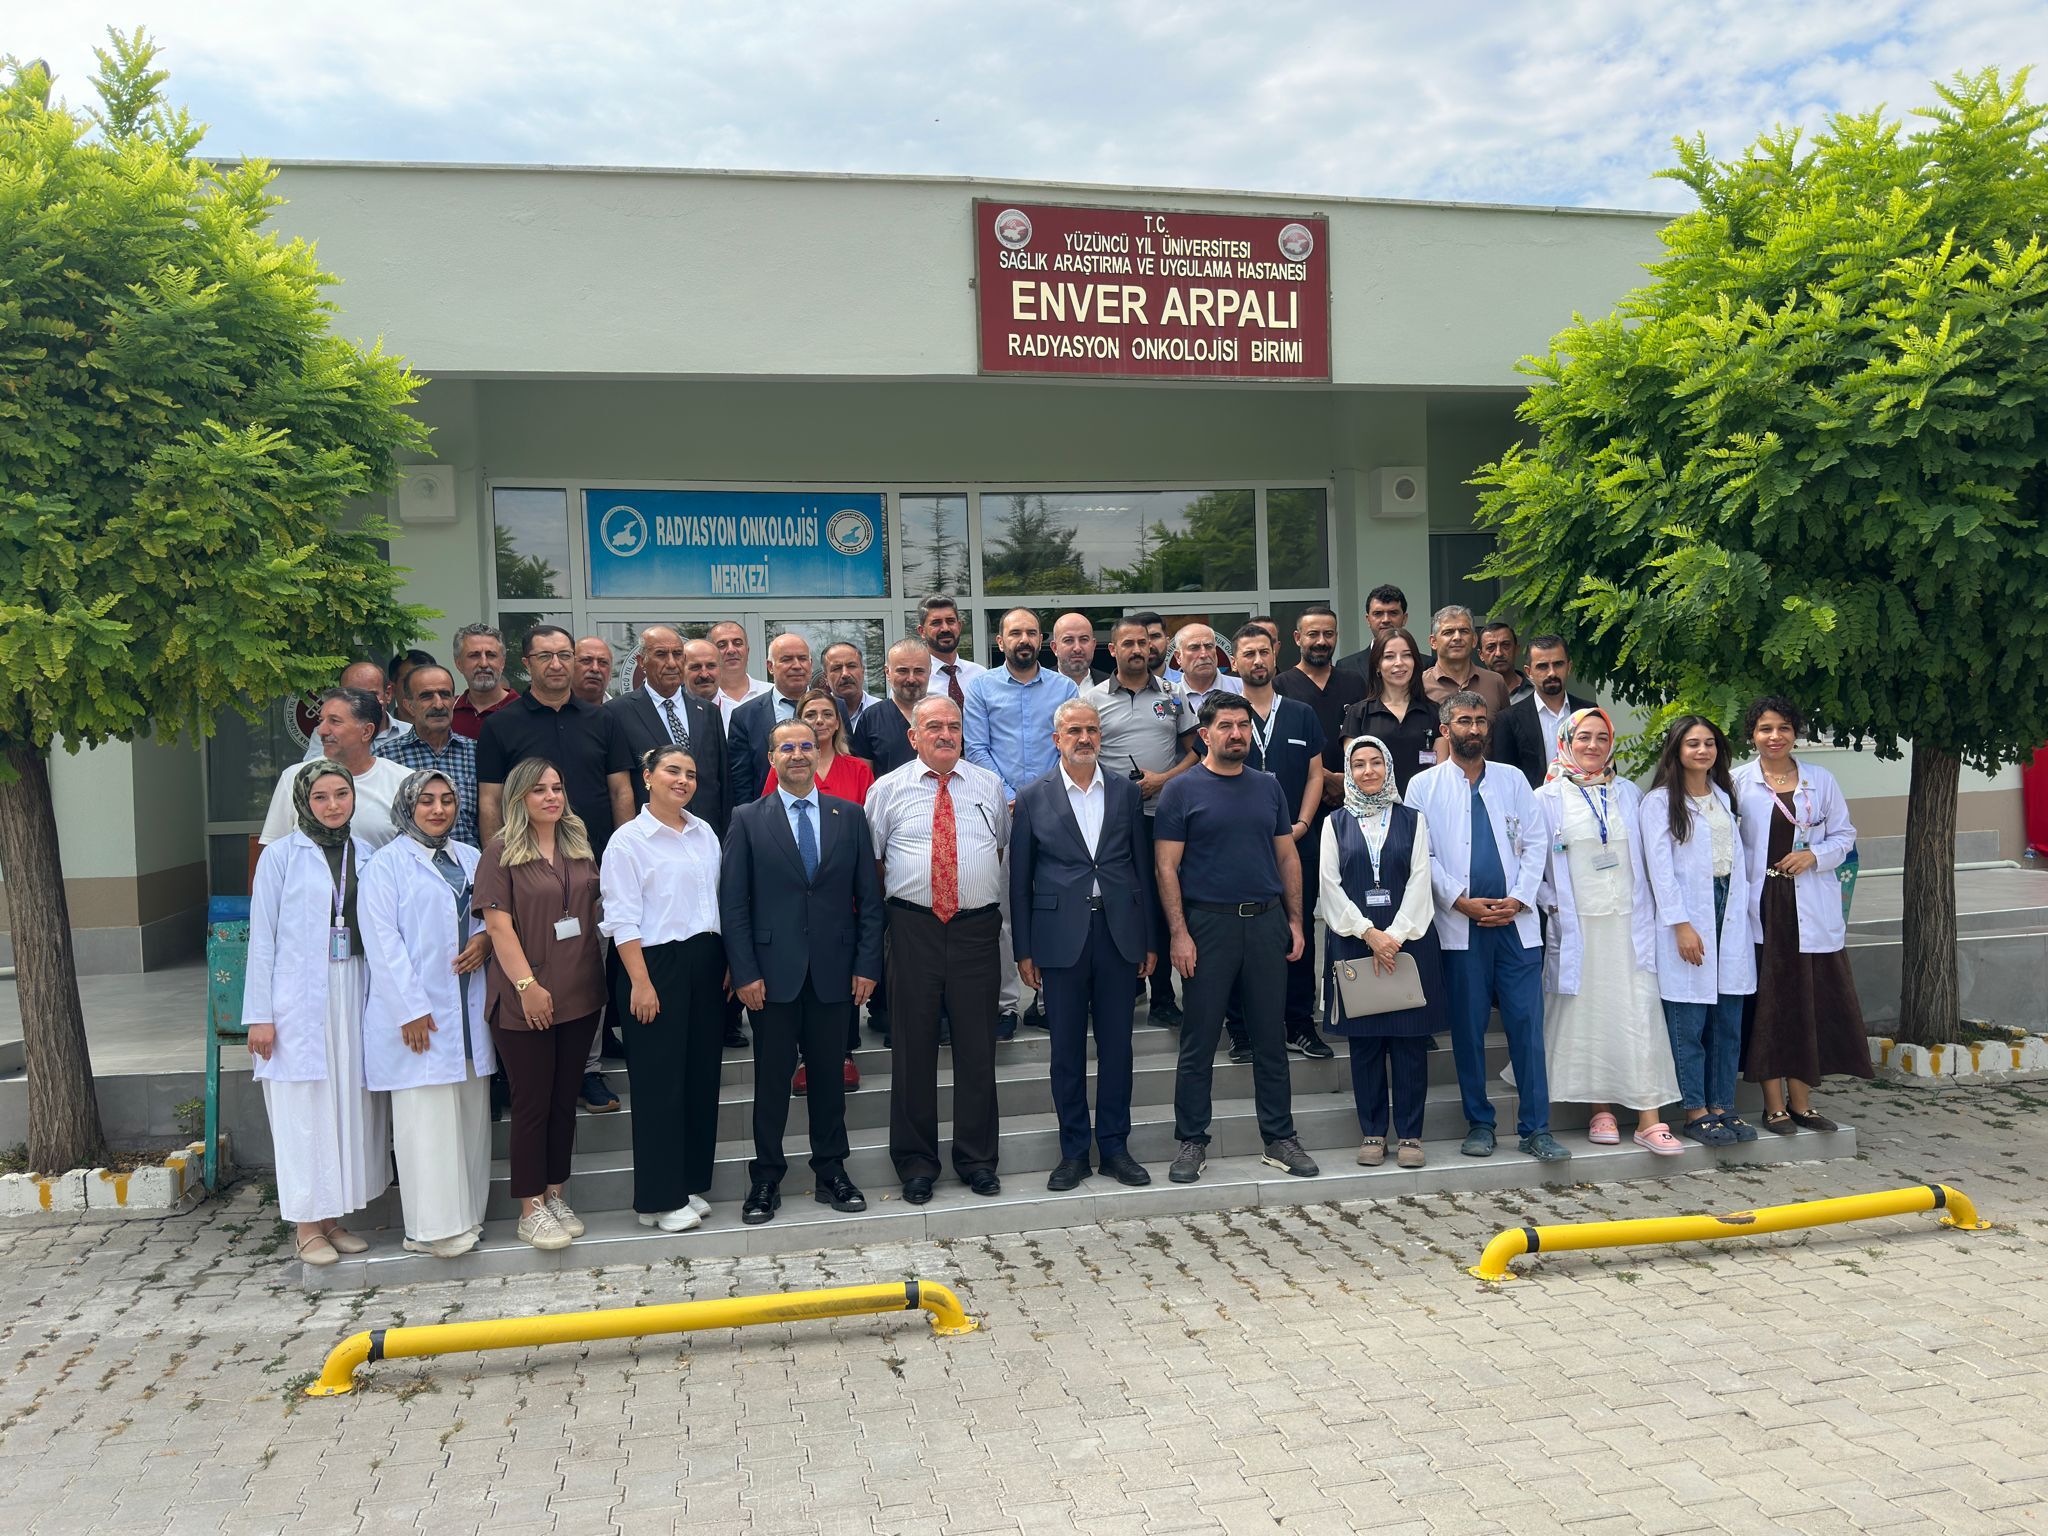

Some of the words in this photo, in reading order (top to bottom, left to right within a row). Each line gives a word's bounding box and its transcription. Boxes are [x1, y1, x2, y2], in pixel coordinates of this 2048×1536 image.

[1144, 215, 1169, 234] T.C.
[1064, 230, 1129, 253] YÜZÜNCÜ
[1136, 237, 1156, 255] YIL
[999, 248, 1048, 271] SAĞLIK
[1053, 253, 1133, 276] ARAŞTIRMA
[1136, 257, 1154, 275] VE
[1160, 258, 1233, 279] UYGULAMA
[1237, 261, 1307, 281] HASTANESİ
[1012, 280, 1149, 325] ENVER
[1160, 286, 1298, 329] ARPALI
[1008, 333, 1120, 359] RADYASYON
[1132, 337, 1238, 362] ONKOLOJİSİ
[1251, 338, 1303, 363] BİRİMİ
[655, 515, 737, 547] RADYASYON
[739, 507, 819, 547] ONKOLOJİSİ
[710, 554, 770, 594] MERKEZİ
